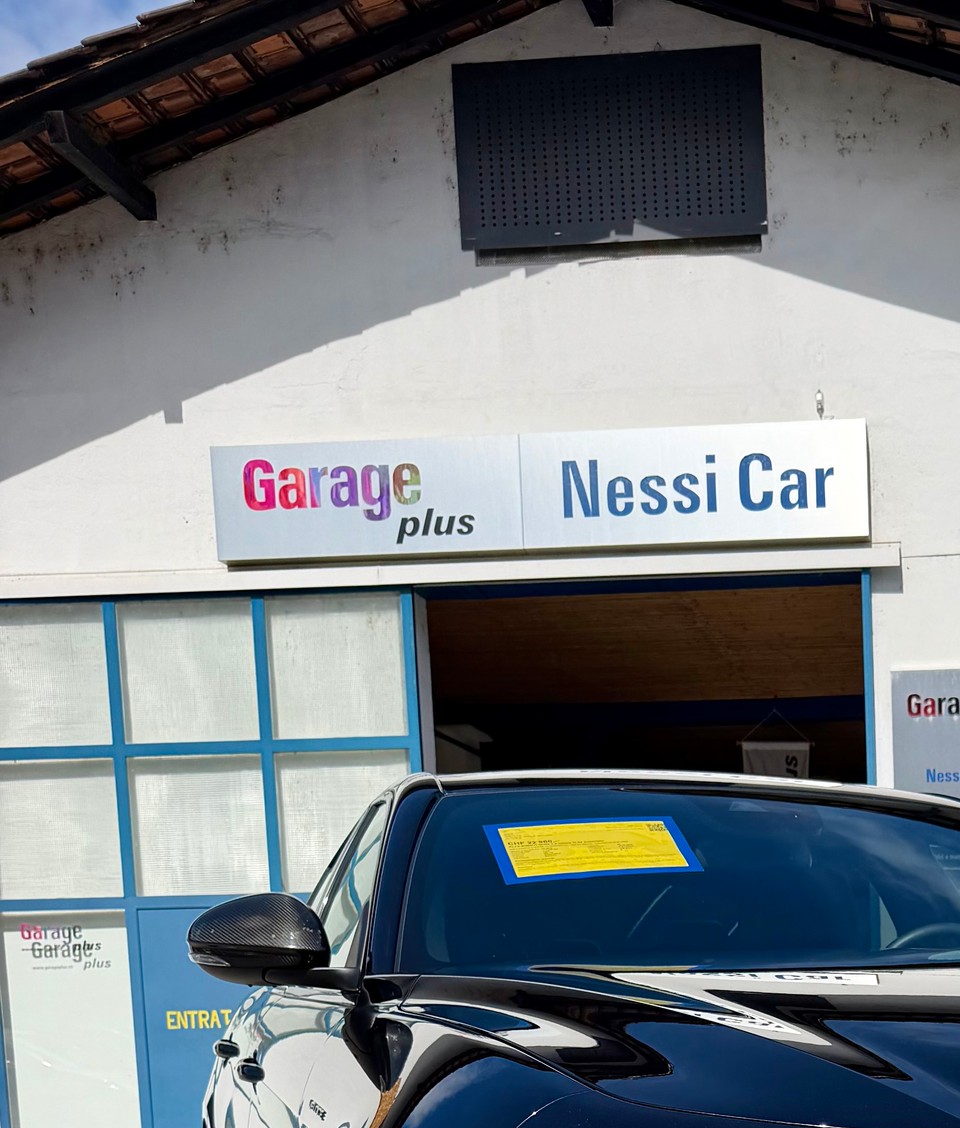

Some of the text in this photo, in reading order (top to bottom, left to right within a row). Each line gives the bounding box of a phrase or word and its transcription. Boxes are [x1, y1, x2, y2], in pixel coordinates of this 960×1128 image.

[242, 458, 421, 521] Garage
[562, 452, 834, 519] Nessi Car
[397, 508, 475, 544] plus
[20, 923, 83, 944] Garage
[84, 958, 112, 971] plus
